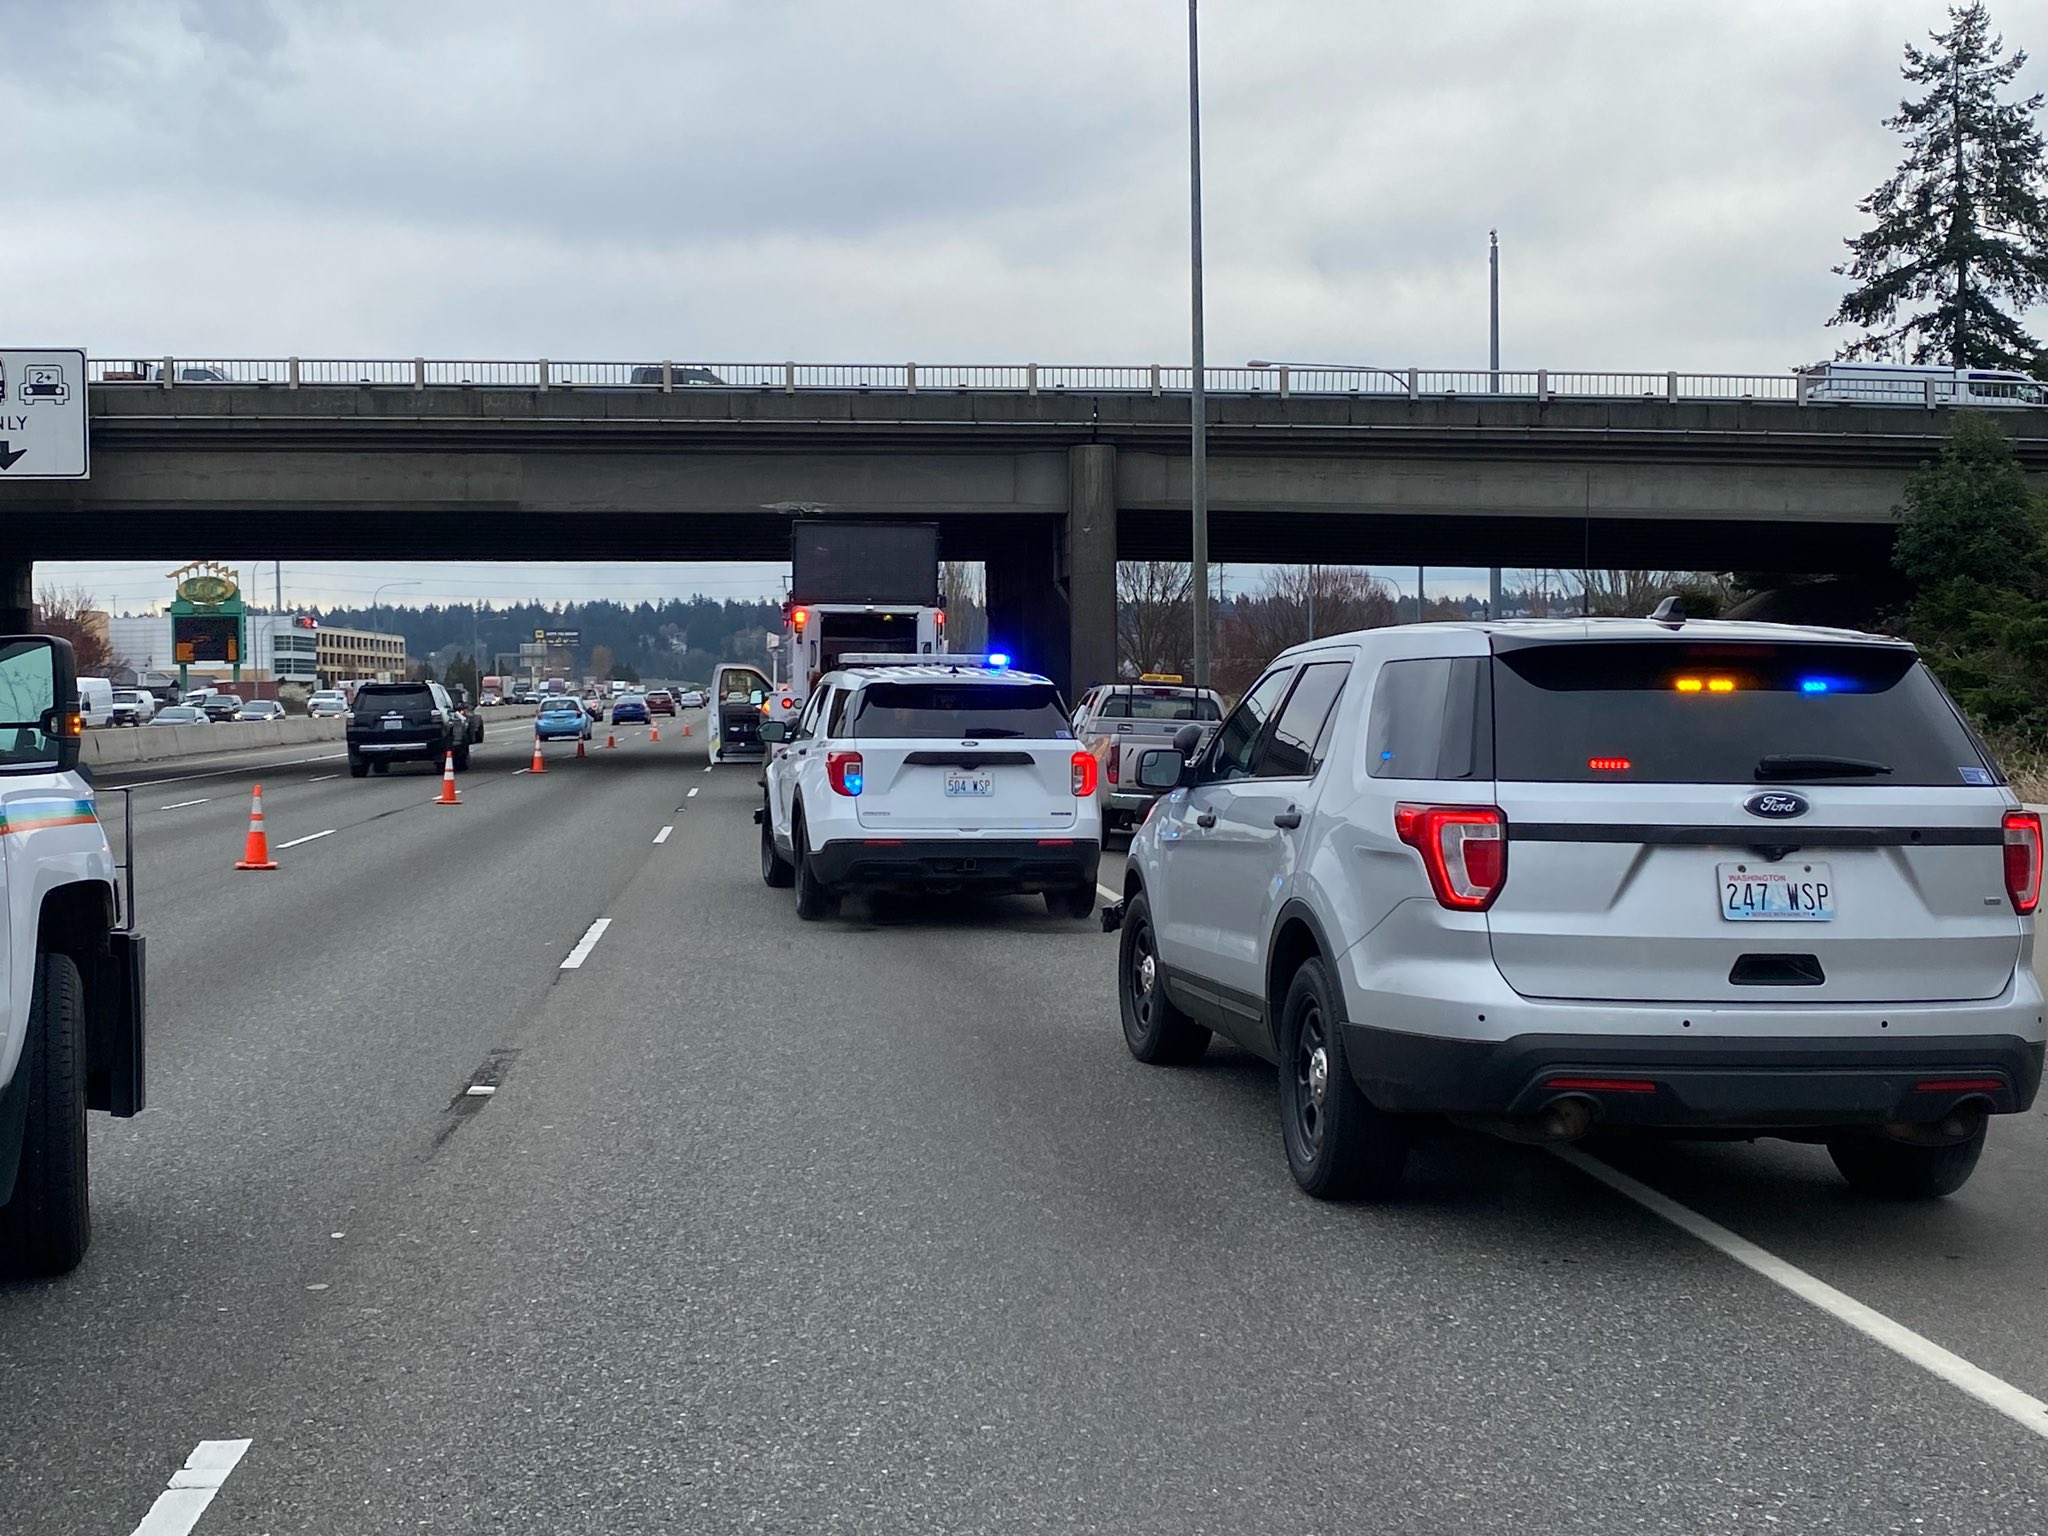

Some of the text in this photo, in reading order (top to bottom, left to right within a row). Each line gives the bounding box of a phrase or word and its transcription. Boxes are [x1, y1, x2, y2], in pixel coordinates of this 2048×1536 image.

[35, 371, 52, 383] 2+
[0, 415, 28, 431] LY
[948, 779, 991, 792] 504 WSP
[1760, 796, 1796, 812] Ford
[1728, 874, 1787, 882] WASHINGTON
[1727, 883, 1829, 911] 247 WSP
